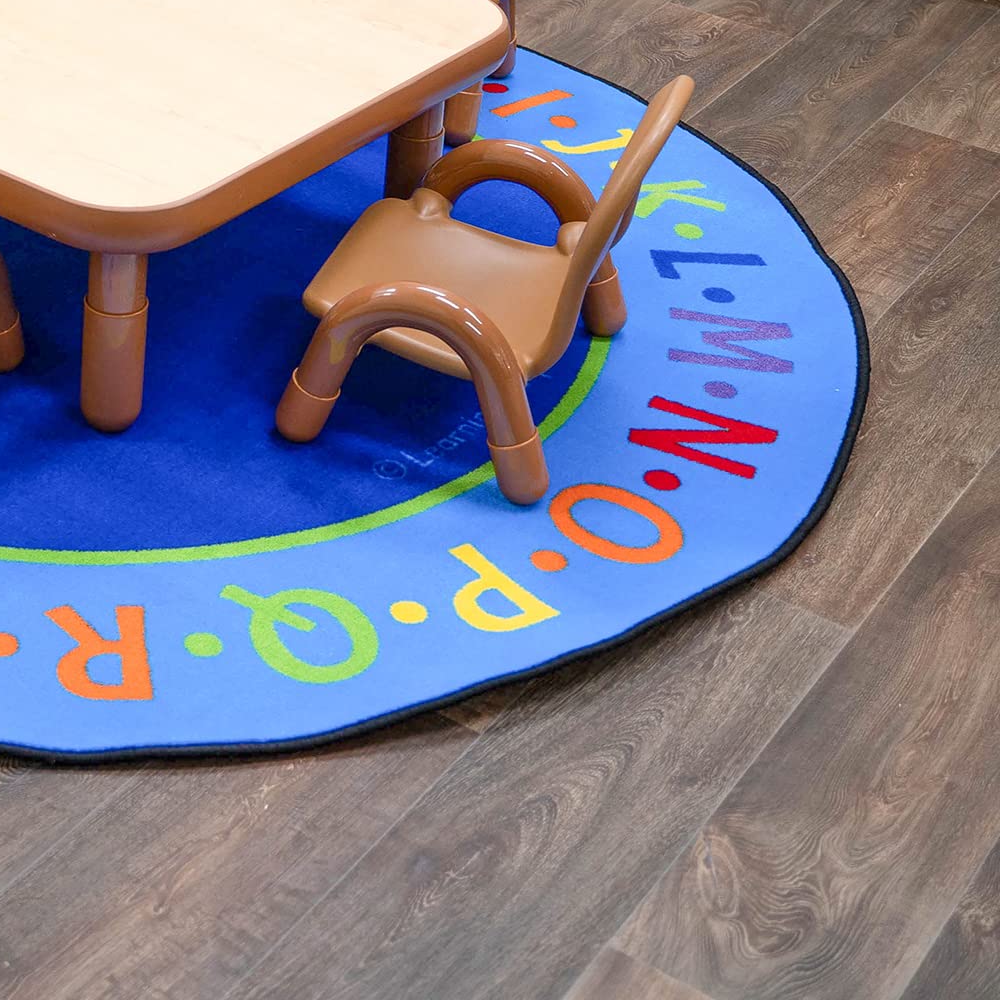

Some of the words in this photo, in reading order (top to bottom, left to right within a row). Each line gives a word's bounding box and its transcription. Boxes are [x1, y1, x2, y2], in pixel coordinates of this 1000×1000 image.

[540, 128, 635, 155] J
[602, 179, 727, 218] K
[649, 248, 768, 280] L
[667, 307, 794, 374] M
[628, 395, 779, 480] N
[547, 483, 684, 564] O
[448, 543, 561, 632] P
[44, 605, 155, 701] R
[220, 584, 379, 684] Q
